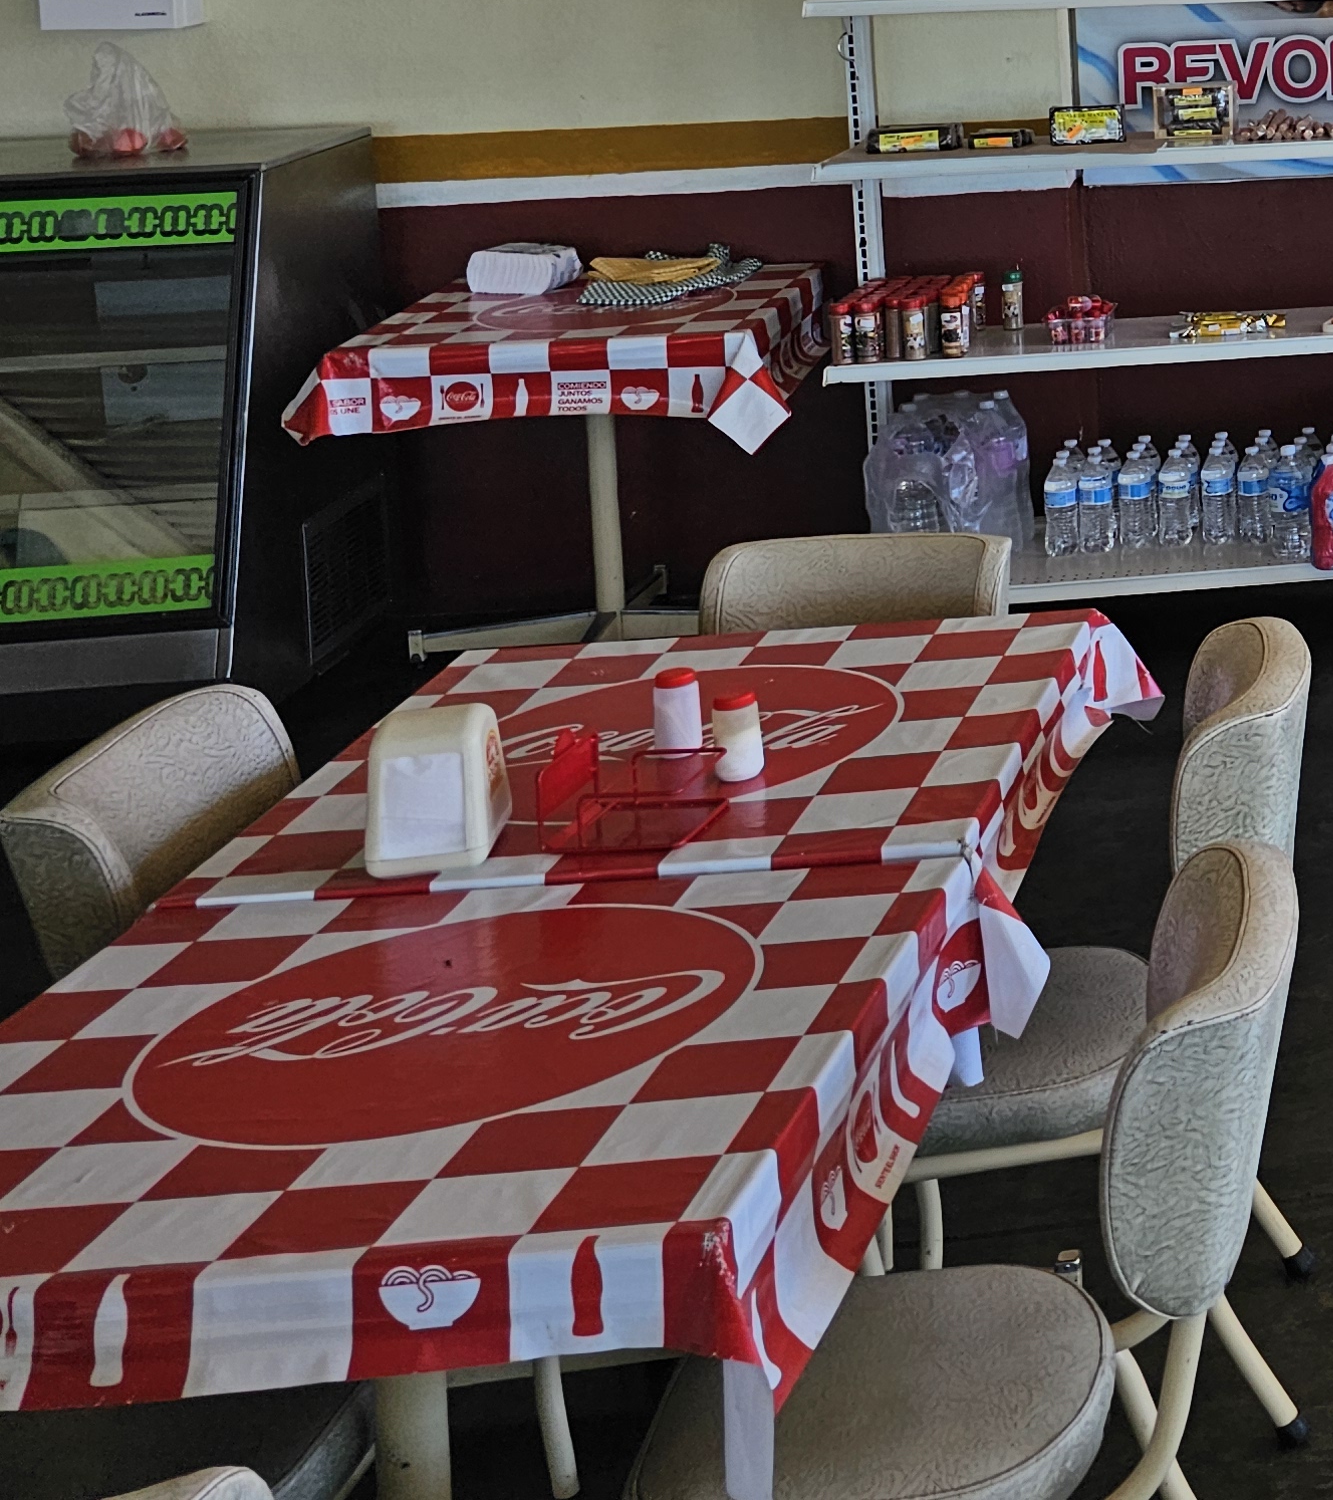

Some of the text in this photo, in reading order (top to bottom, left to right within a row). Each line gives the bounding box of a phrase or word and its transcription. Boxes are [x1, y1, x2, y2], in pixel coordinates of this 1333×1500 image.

[557, 381, 607, 390] COMIENDO
[557, 397, 604, 405] GANAMOS
[557, 405, 588, 413] TODOS
